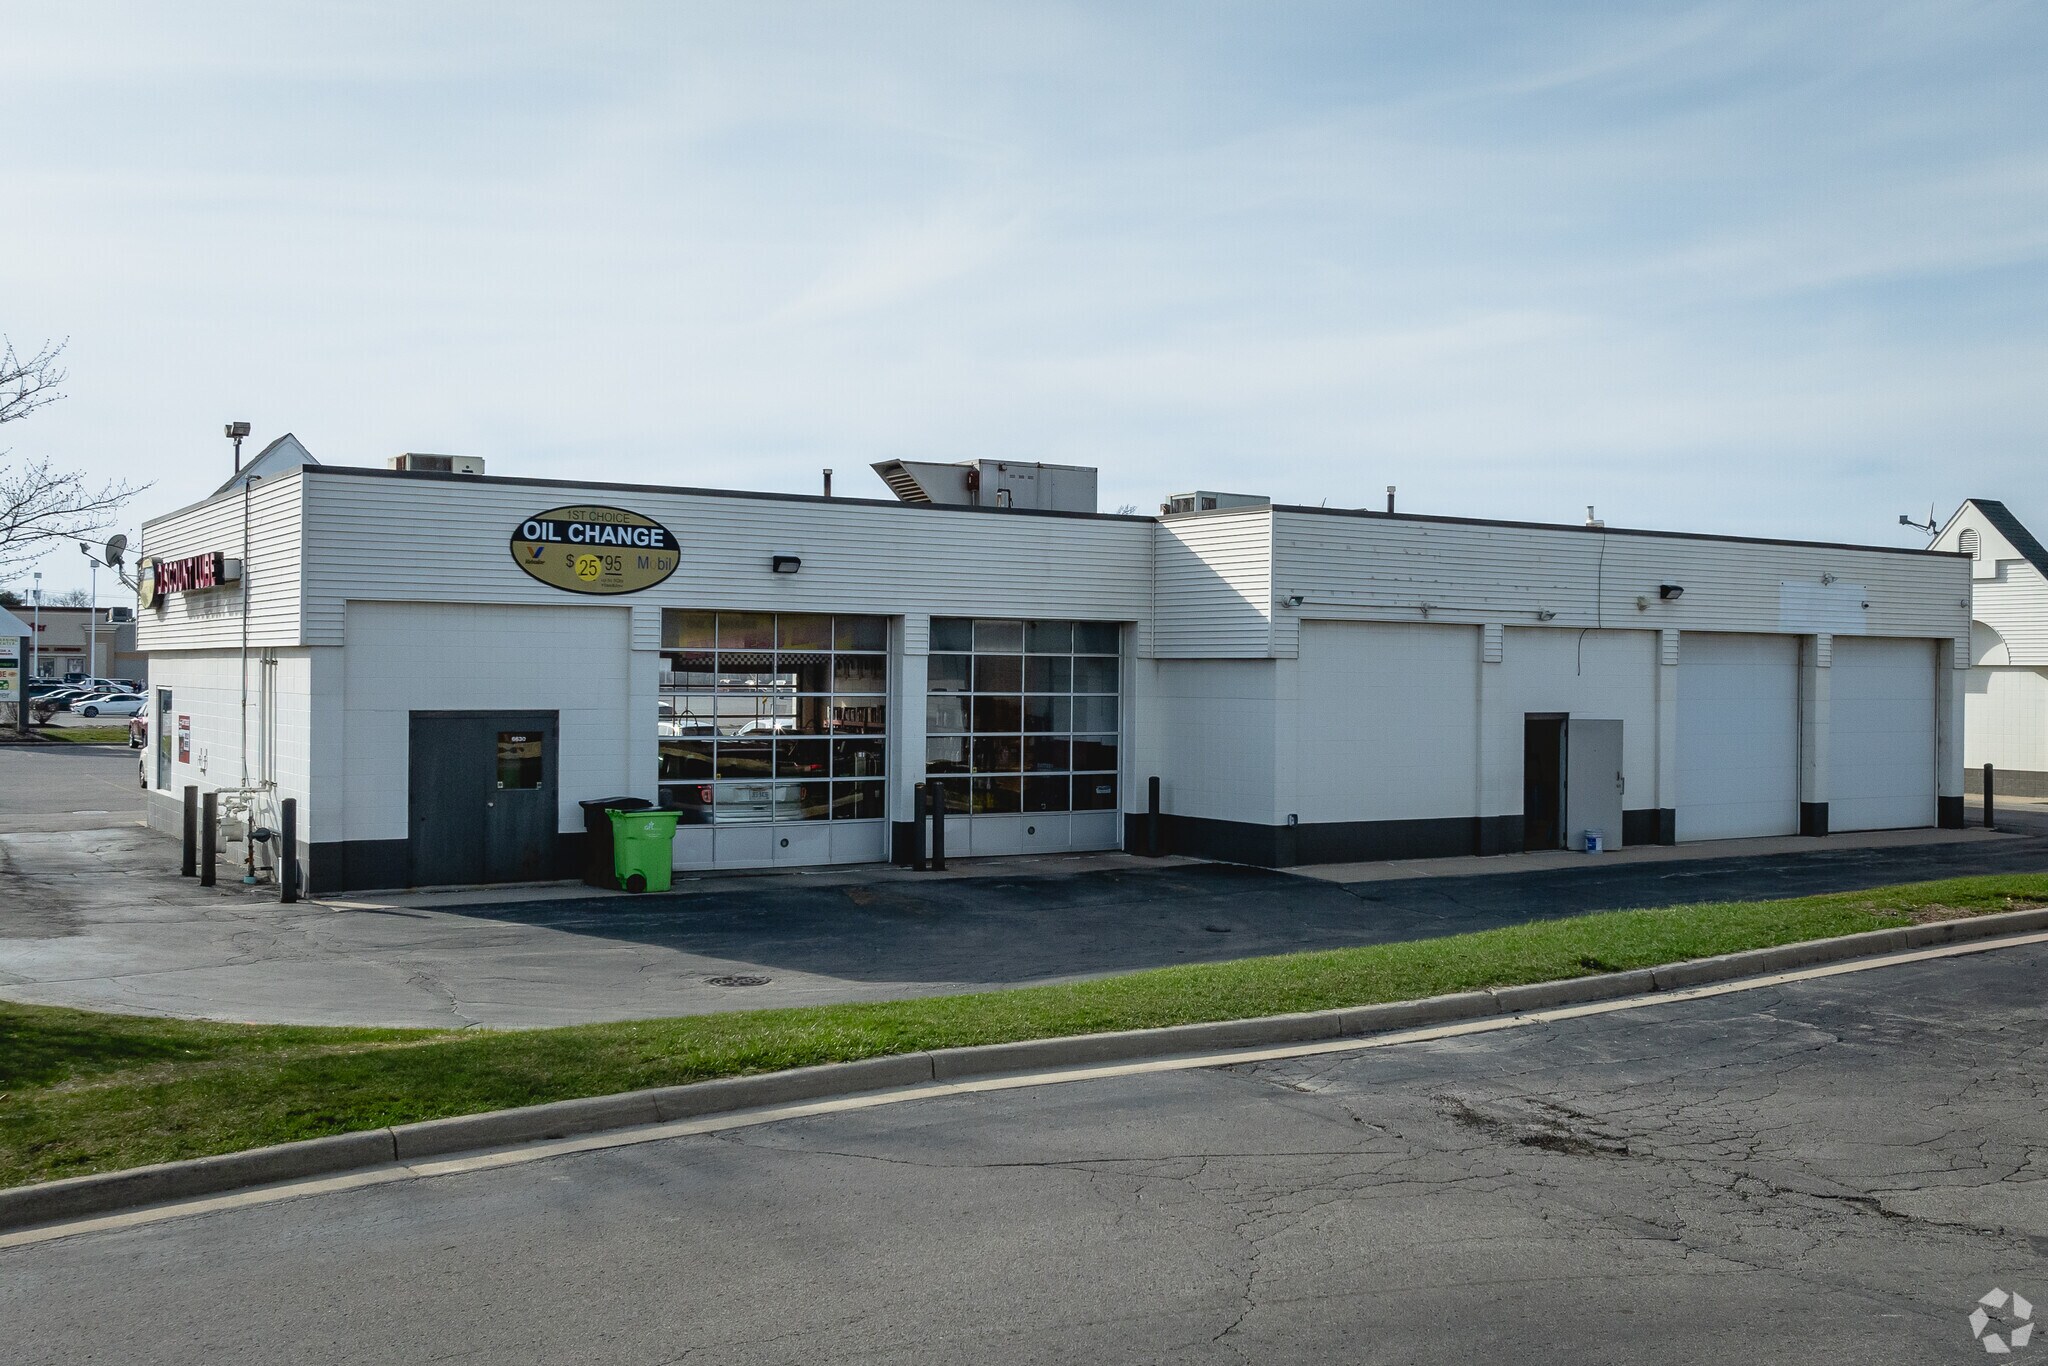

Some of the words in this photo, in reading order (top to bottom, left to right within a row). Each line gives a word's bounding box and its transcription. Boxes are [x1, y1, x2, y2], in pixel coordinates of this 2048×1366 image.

[567, 511, 587, 520] 1ST
[589, 511, 630, 523] CHOICE
[523, 521, 561, 541] OIL
[568, 523, 664, 547] CHANGE
[194, 553, 216, 589] LUBE
[579, 560, 597, 576] 25
[605, 555, 622, 571] 95
